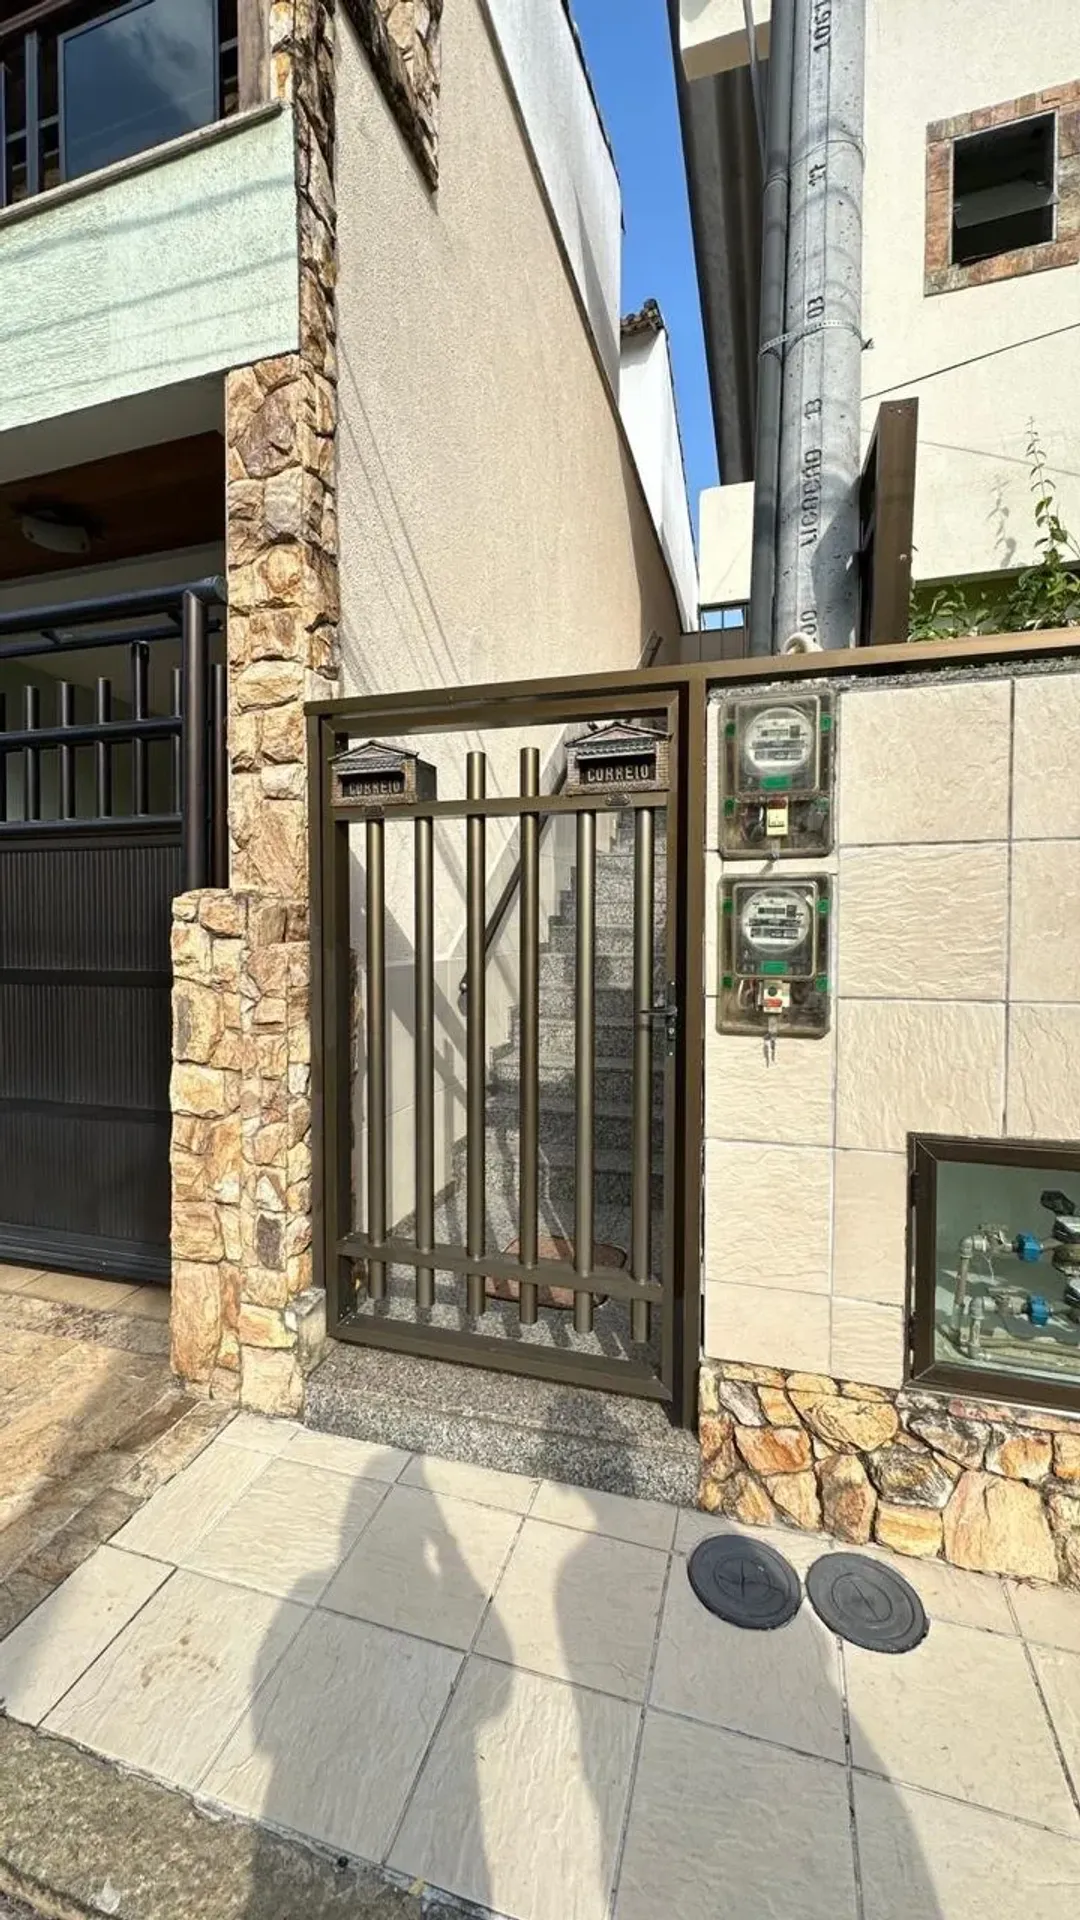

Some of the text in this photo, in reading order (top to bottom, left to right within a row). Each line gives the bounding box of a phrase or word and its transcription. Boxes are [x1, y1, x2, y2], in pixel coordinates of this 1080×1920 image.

[806, 295, 825, 319] 03
[587, 764, 649, 782] CORREIO
[348, 780, 401, 796] CORREIO
